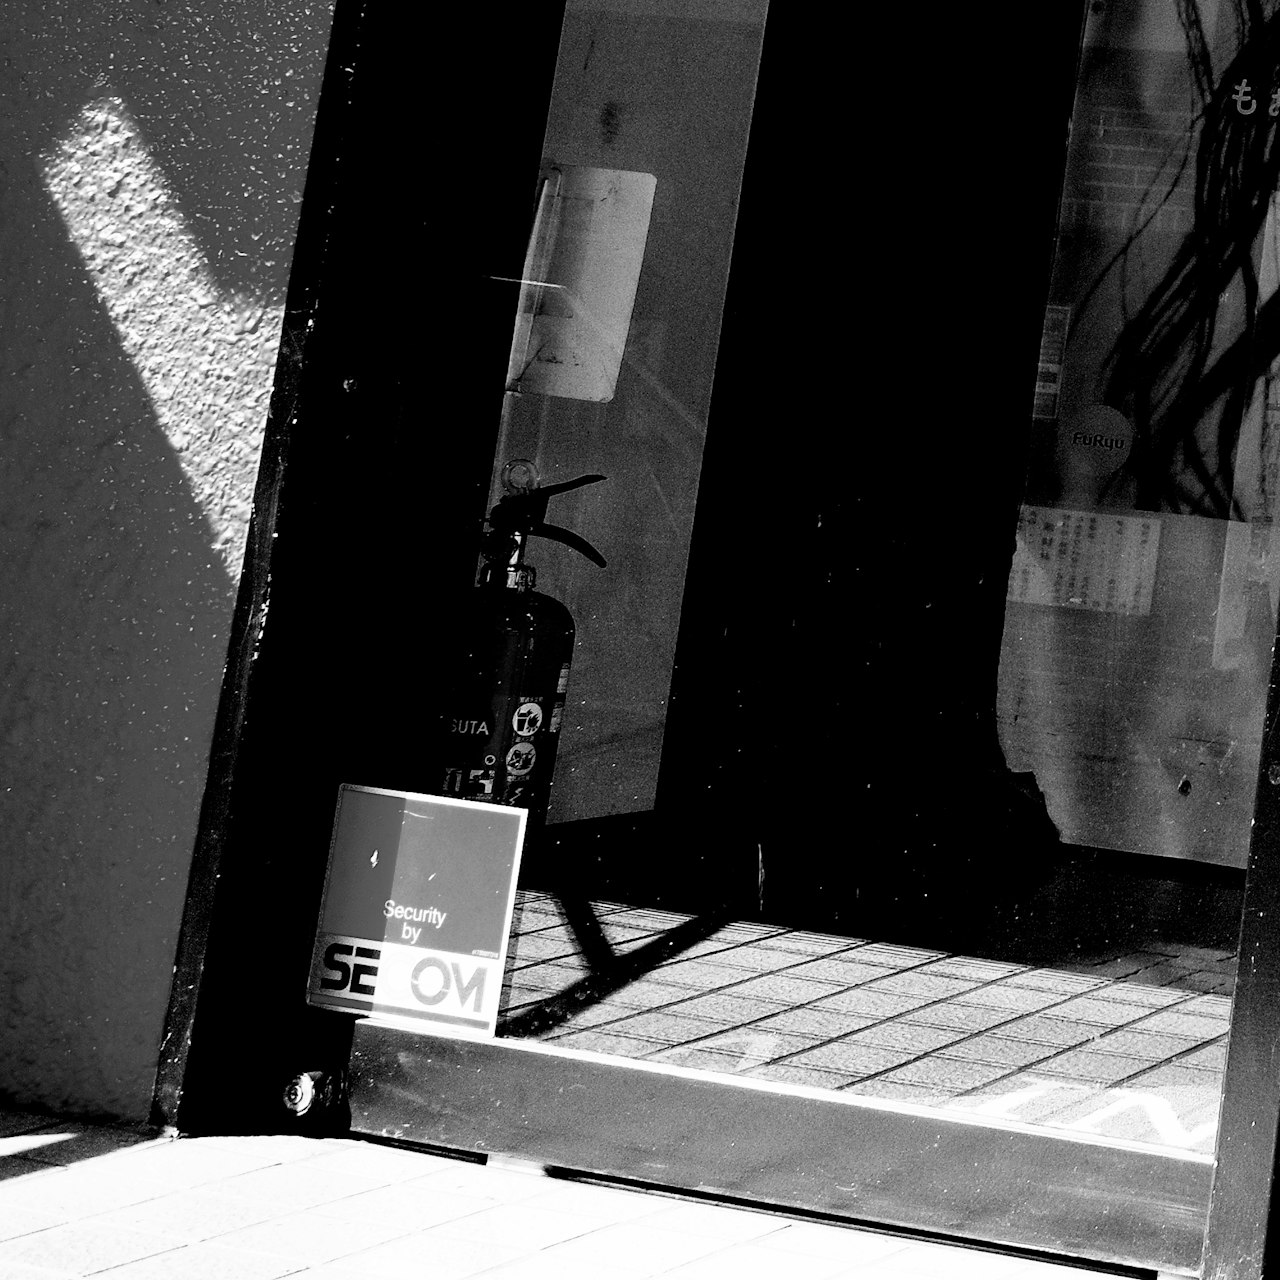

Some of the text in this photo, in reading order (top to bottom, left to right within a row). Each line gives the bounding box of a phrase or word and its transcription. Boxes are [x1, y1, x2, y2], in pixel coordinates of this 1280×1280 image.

[383, 900, 447, 929] Security
[400, 923, 422, 944] by
[320, 942, 488, 1013] SEOM
